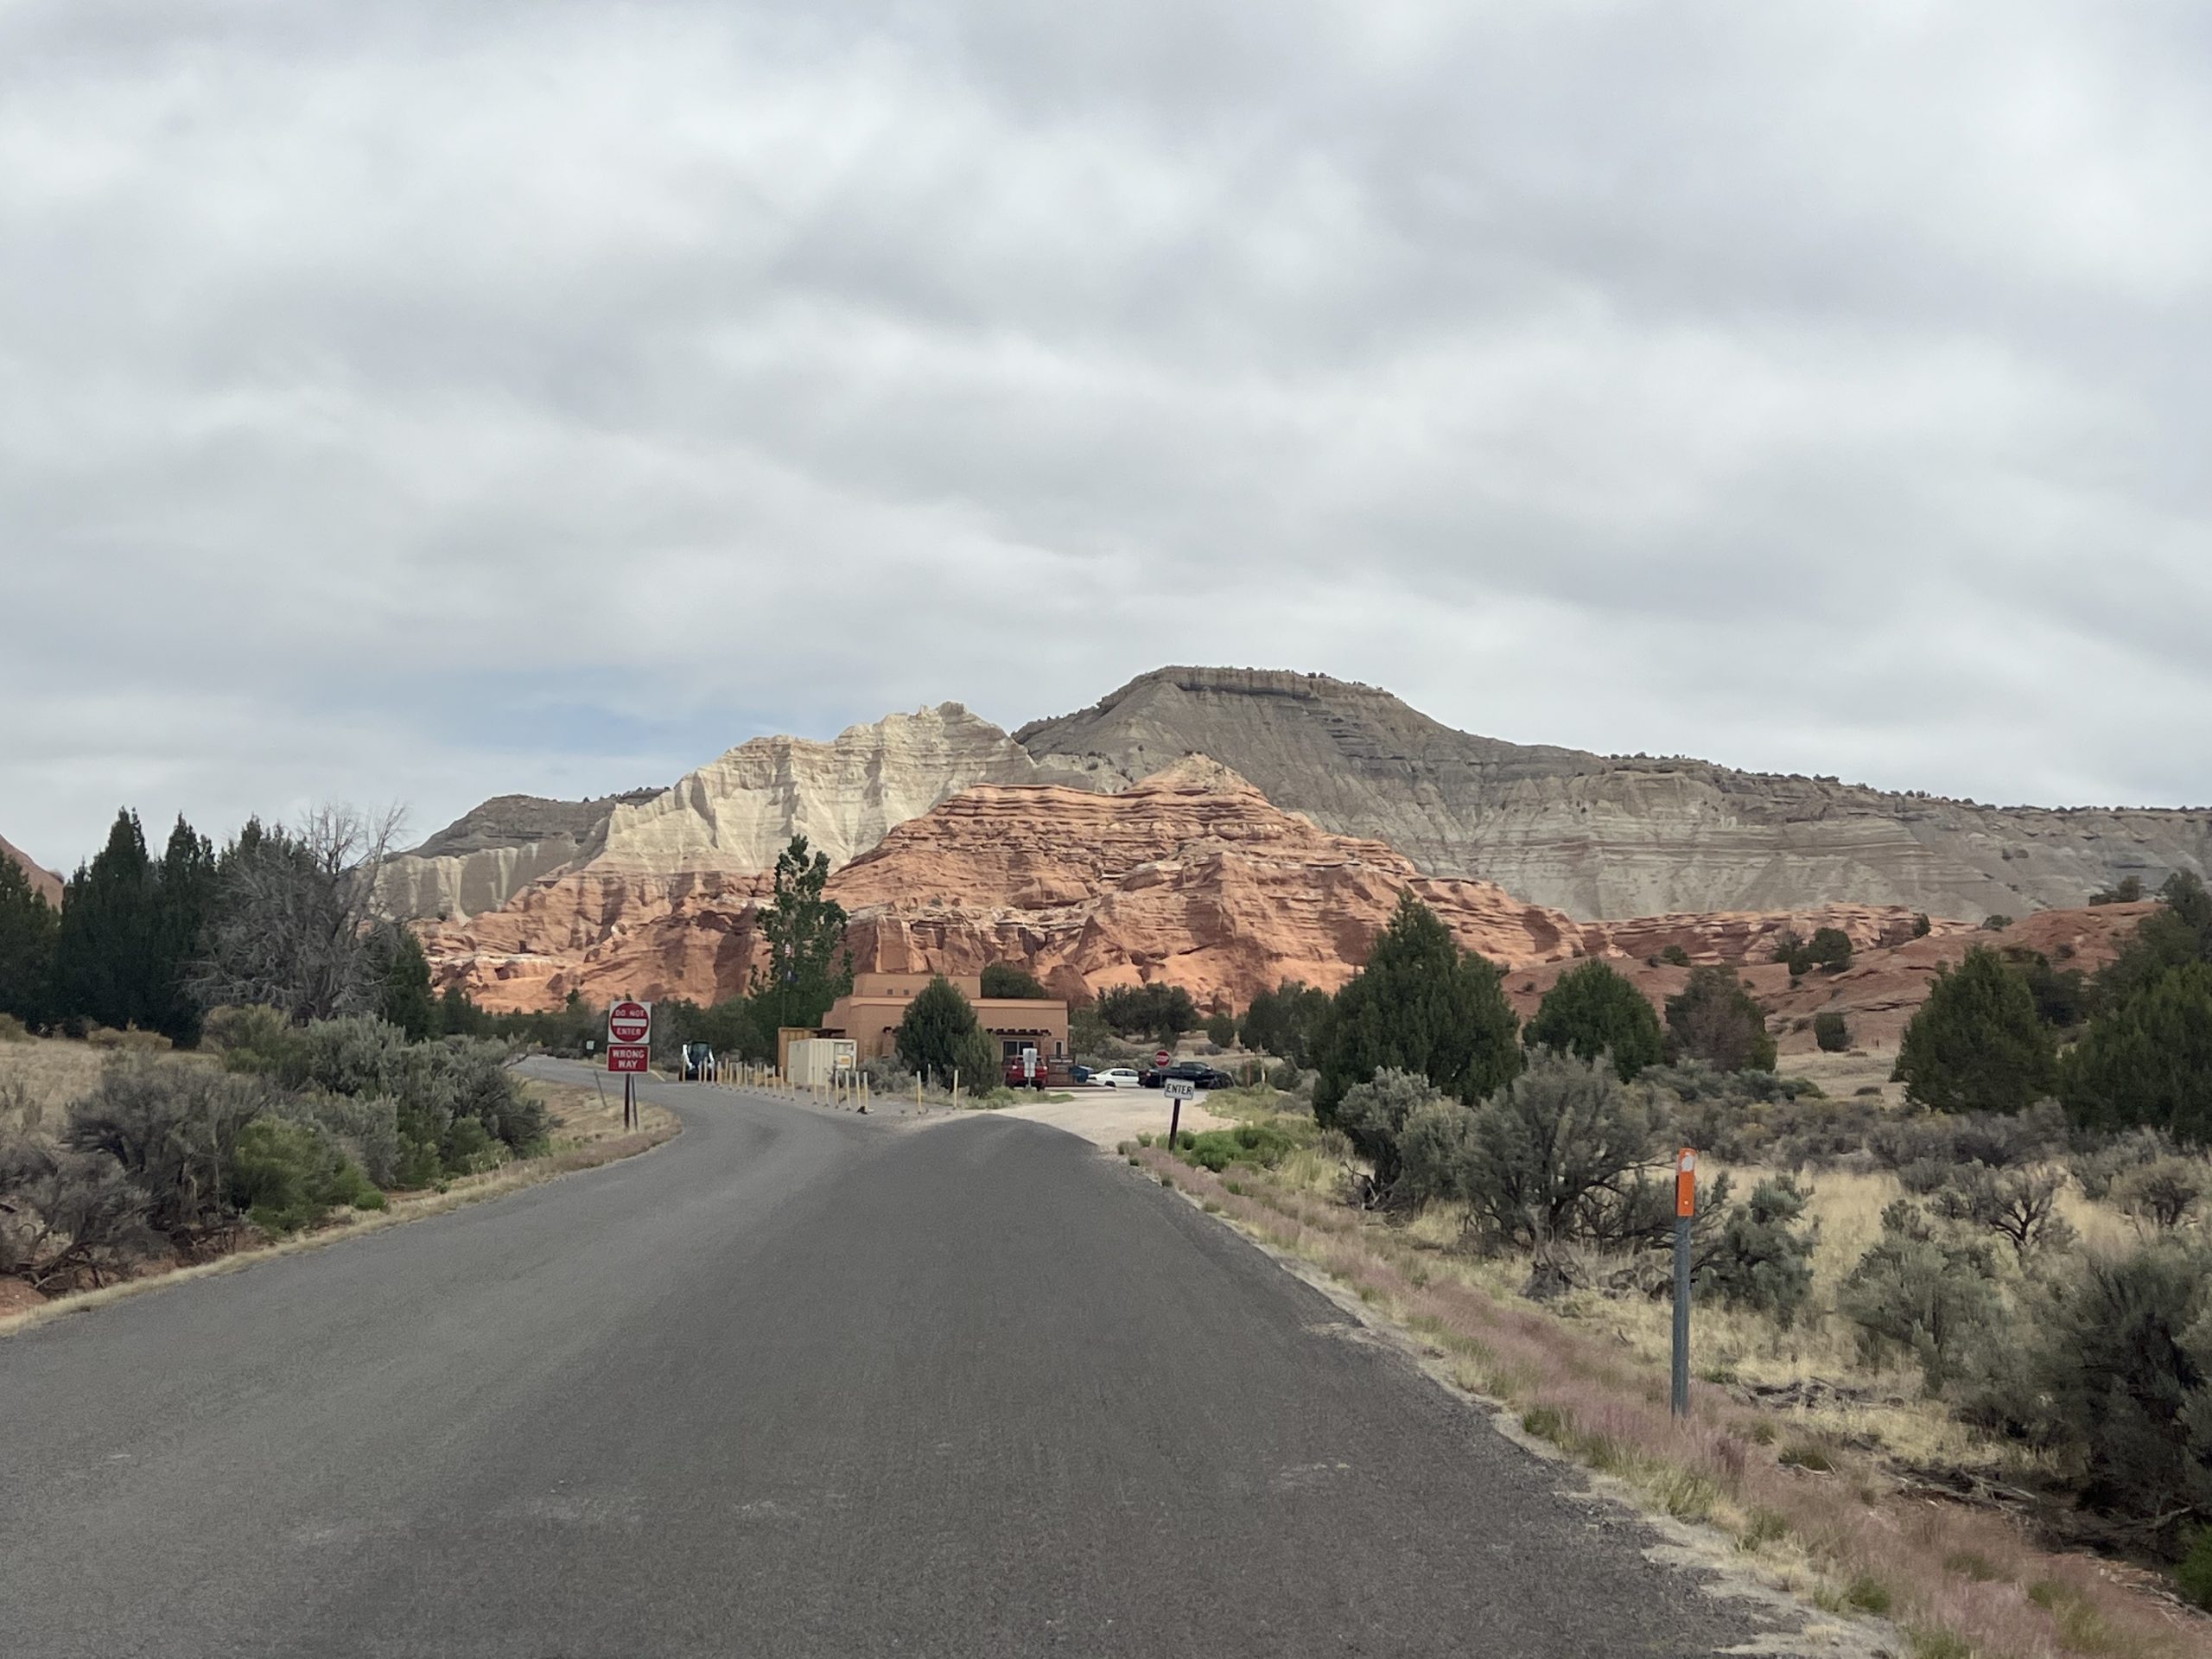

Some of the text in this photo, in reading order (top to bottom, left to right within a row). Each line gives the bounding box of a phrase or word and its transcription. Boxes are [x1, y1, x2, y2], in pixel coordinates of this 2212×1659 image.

[612, 1050, 645, 1058] WRONG
[618, 1059, 638, 1068] WAY
[1166, 1084, 1192, 1095] ENTER
